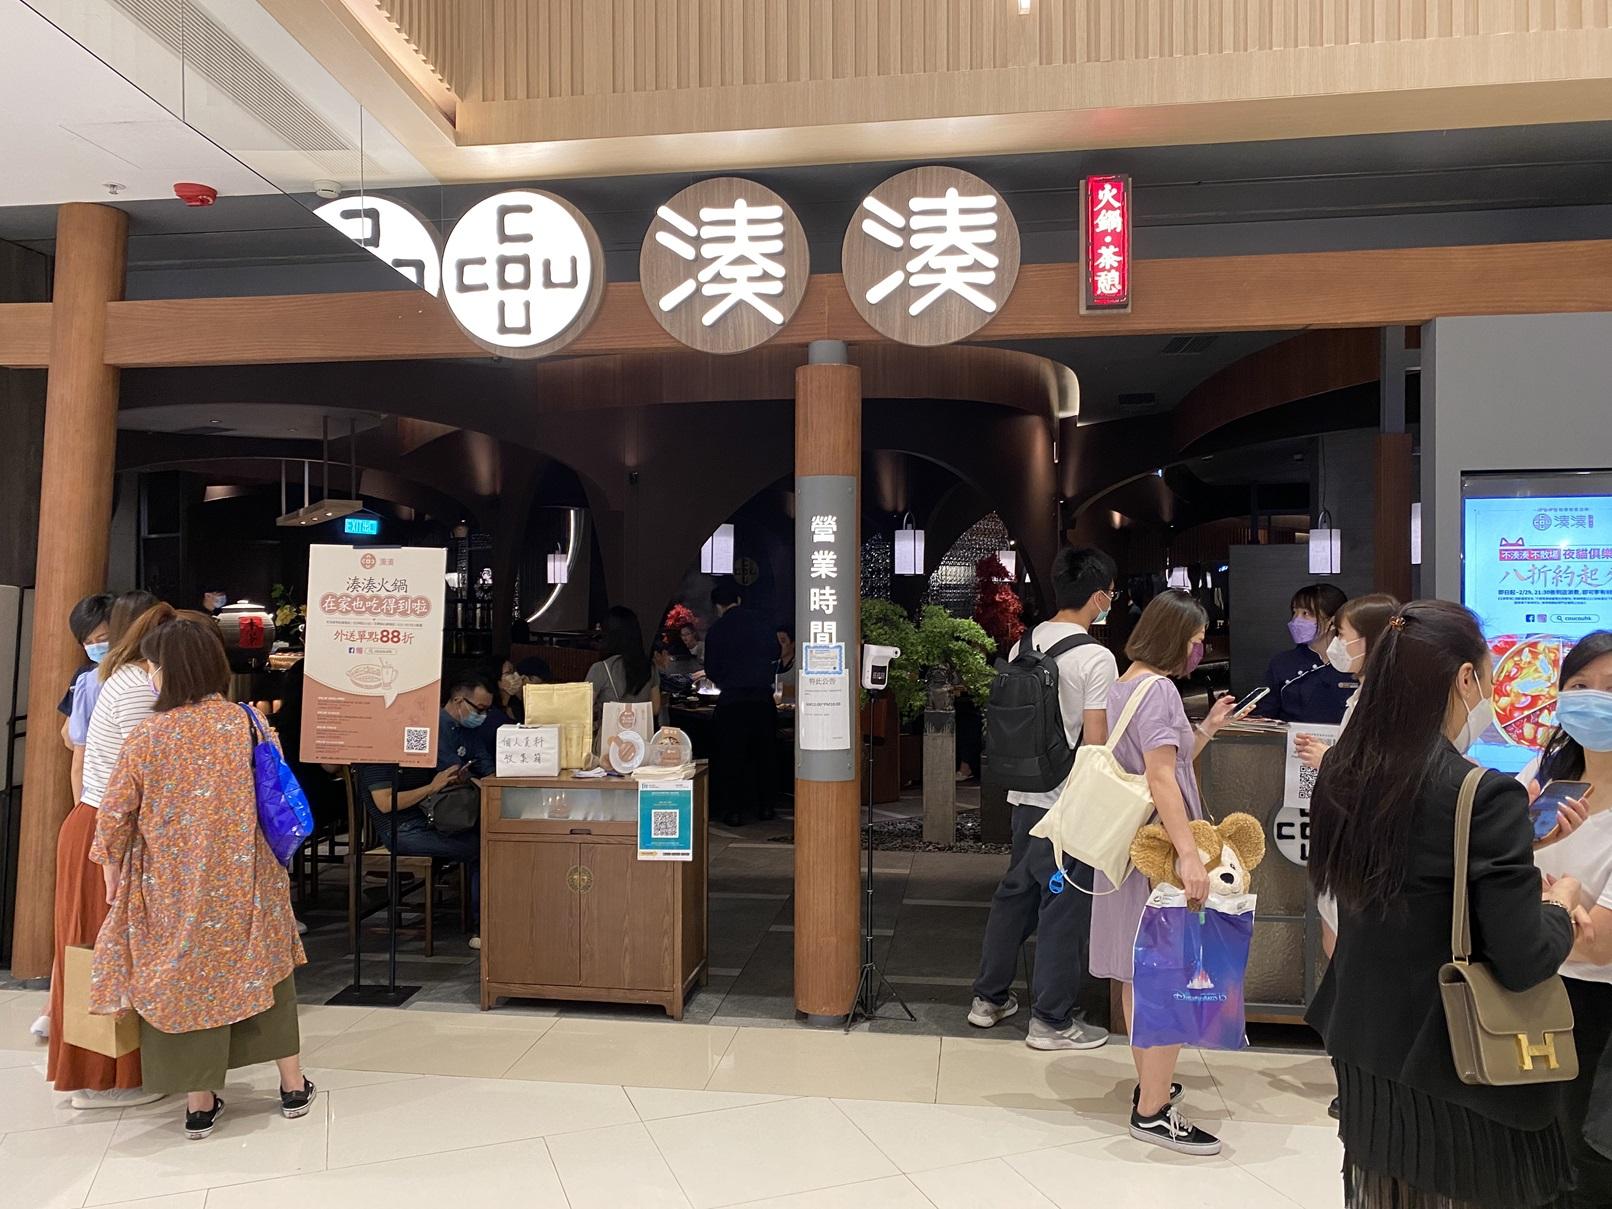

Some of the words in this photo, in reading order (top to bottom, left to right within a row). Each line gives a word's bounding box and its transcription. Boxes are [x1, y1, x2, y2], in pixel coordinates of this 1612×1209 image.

[655, 187, 999, 327] 湊湊
[346, 576, 408, 593] 湊湊火鍋
[810, 515, 837, 646] 營業時間
[322, 595, 428, 614] 在家也吃得到啦
[334, 629, 415, 645] 外送單點88折
